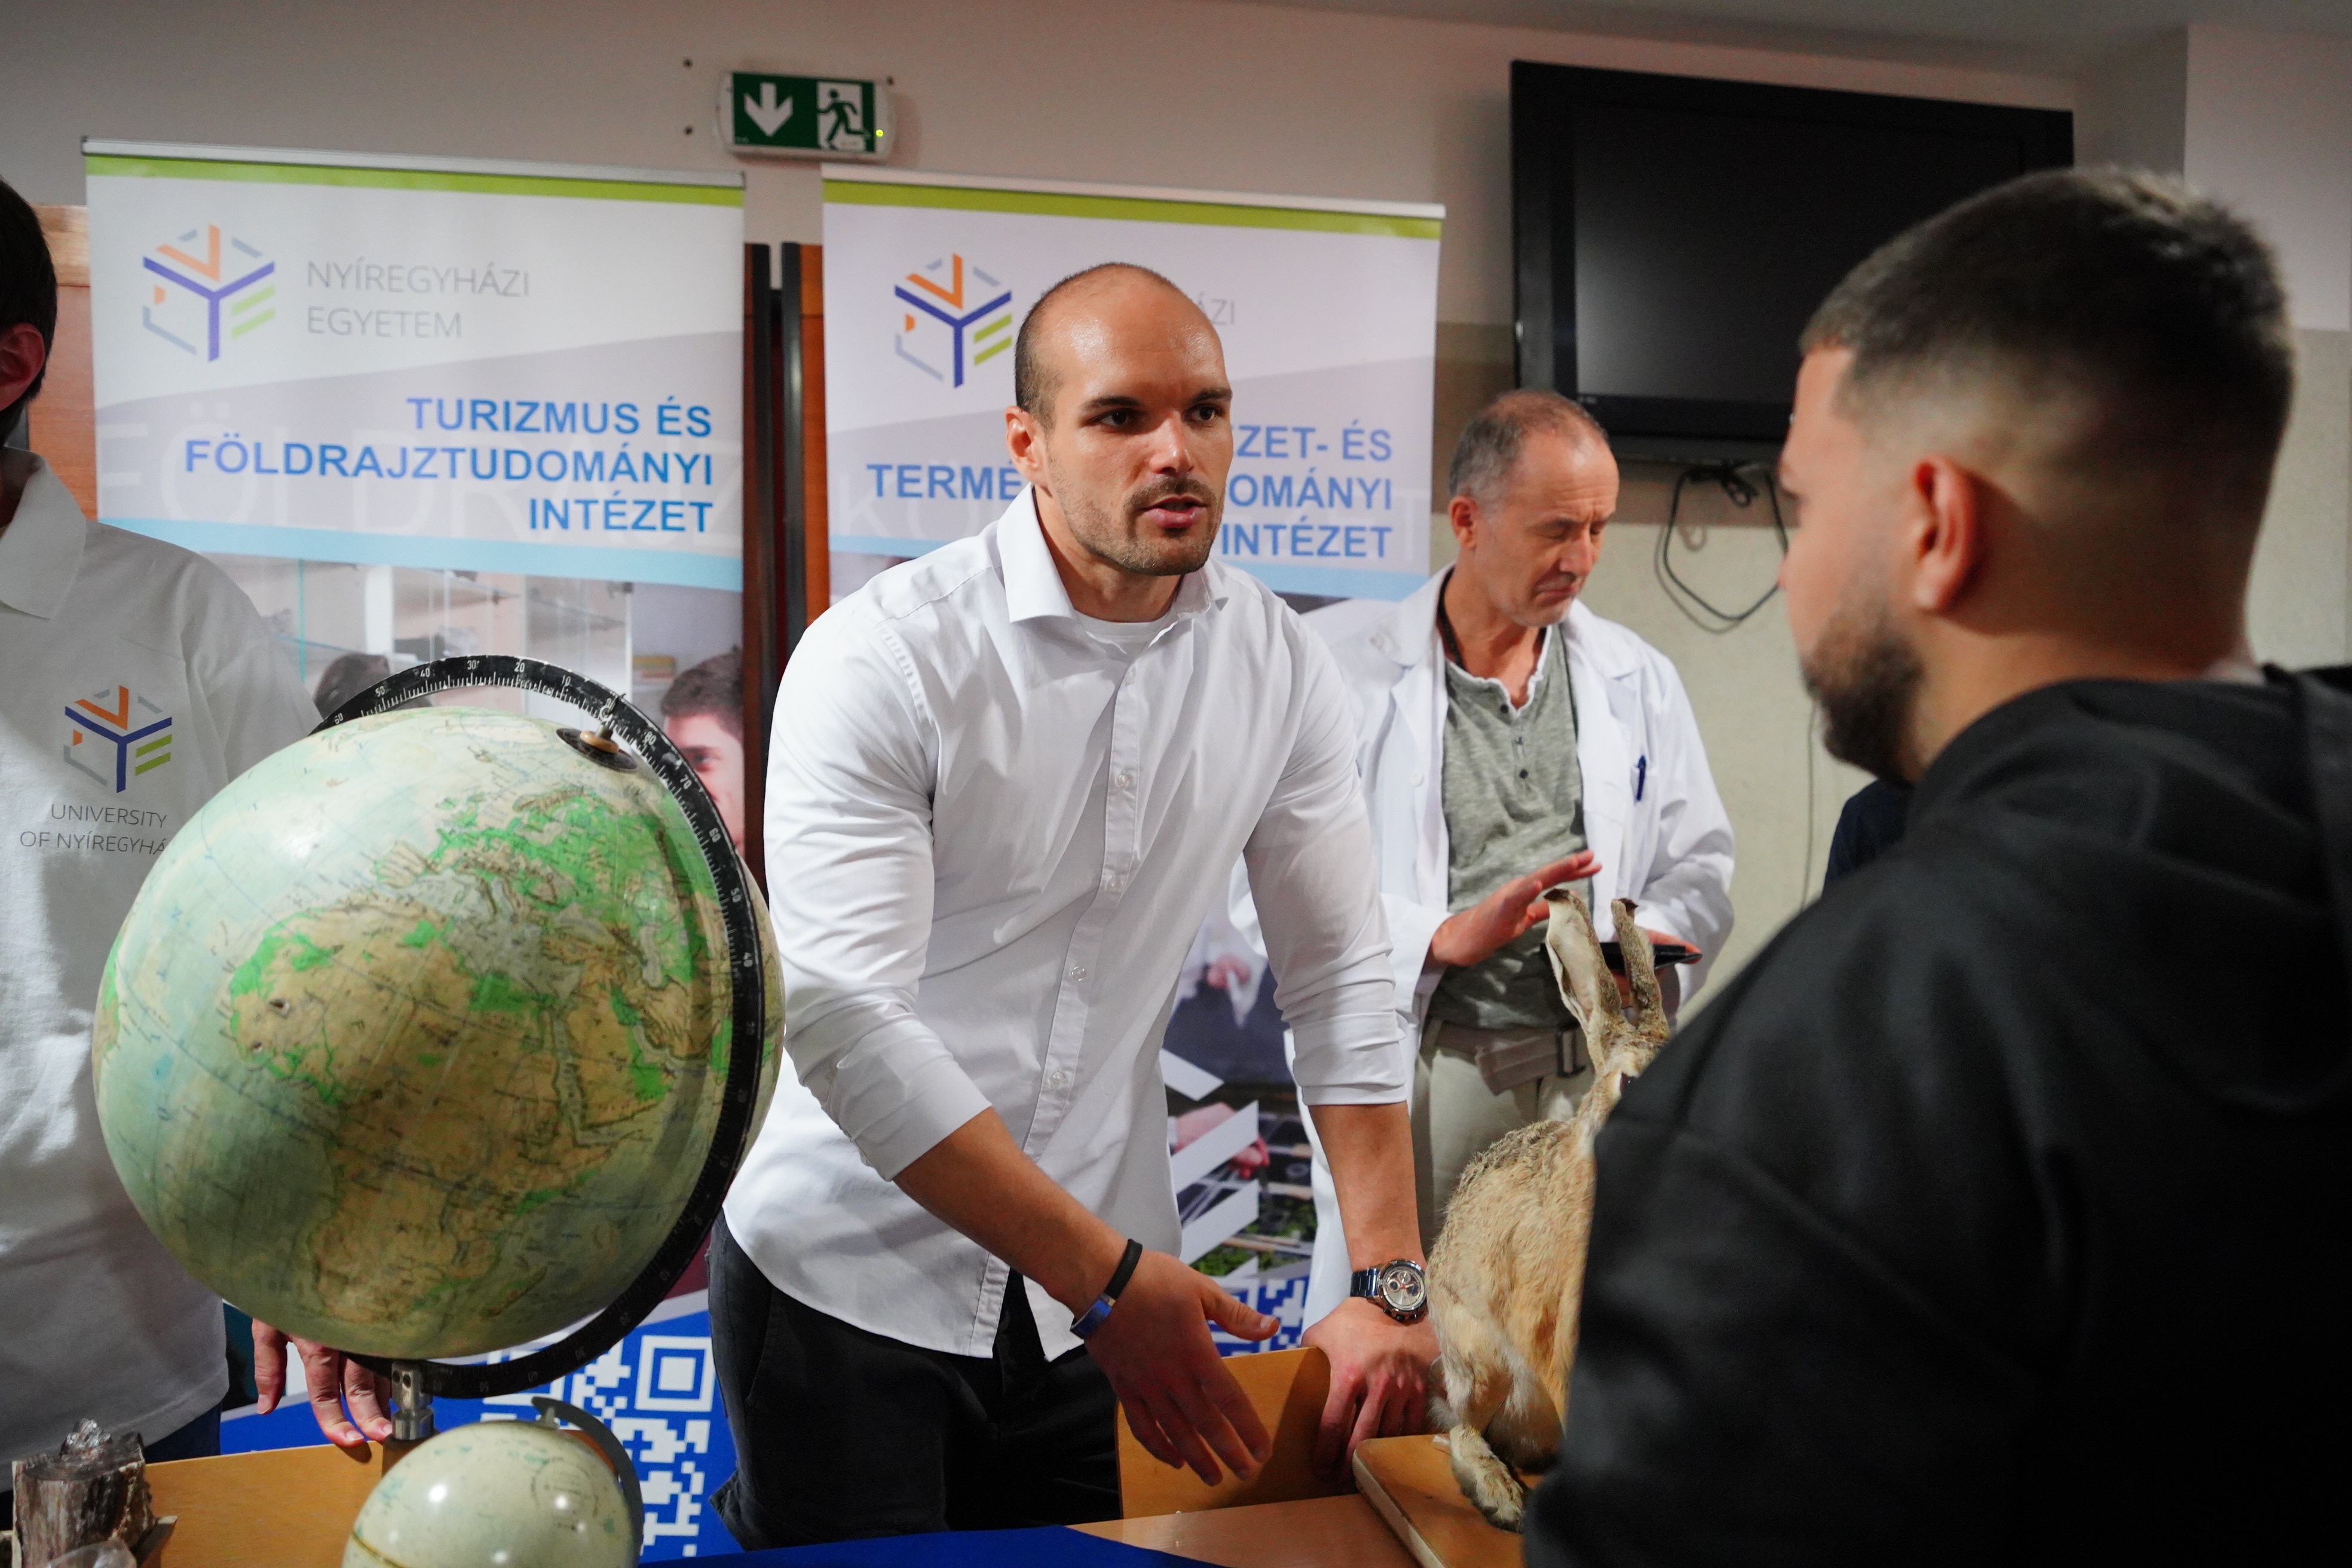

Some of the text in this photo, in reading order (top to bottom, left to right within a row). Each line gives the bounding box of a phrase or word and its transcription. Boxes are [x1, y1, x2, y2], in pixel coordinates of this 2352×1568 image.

[307, 257, 529, 298] NYÍREGYHÁZI
[307, 307, 462, 339] EGYETEM
[1196, 290, 1235, 326] ÁZI
[406, 396, 712, 437] TURIZMUS ÉS
[185, 433, 712, 485] FÖLDRAJZTUDOMÁNYI
[1231, 419, 1392, 461] ZET- ÉS
[866, 460, 1391, 510] TERMÉ OMÁNYI
[529, 490, 713, 532] INTÉZET
[1222, 515, 1393, 558] INTÉZET
[335, 713, 344, 725] 60
[375, 686, 385, 697] 50
[419, 667, 430, 678] 40
[467, 660, 477, 670] 30
[514, 662, 525, 673] 20
[561, 675, 571, 687] 10
[679, 774, 693, 789] 70
[709, 828, 721, 843] 60
[730, 887, 741, 903] 50
[51, 804, 167, 828] UNIVERSITY
[20, 831, 166, 855] OF NYÍREGYHÁ
